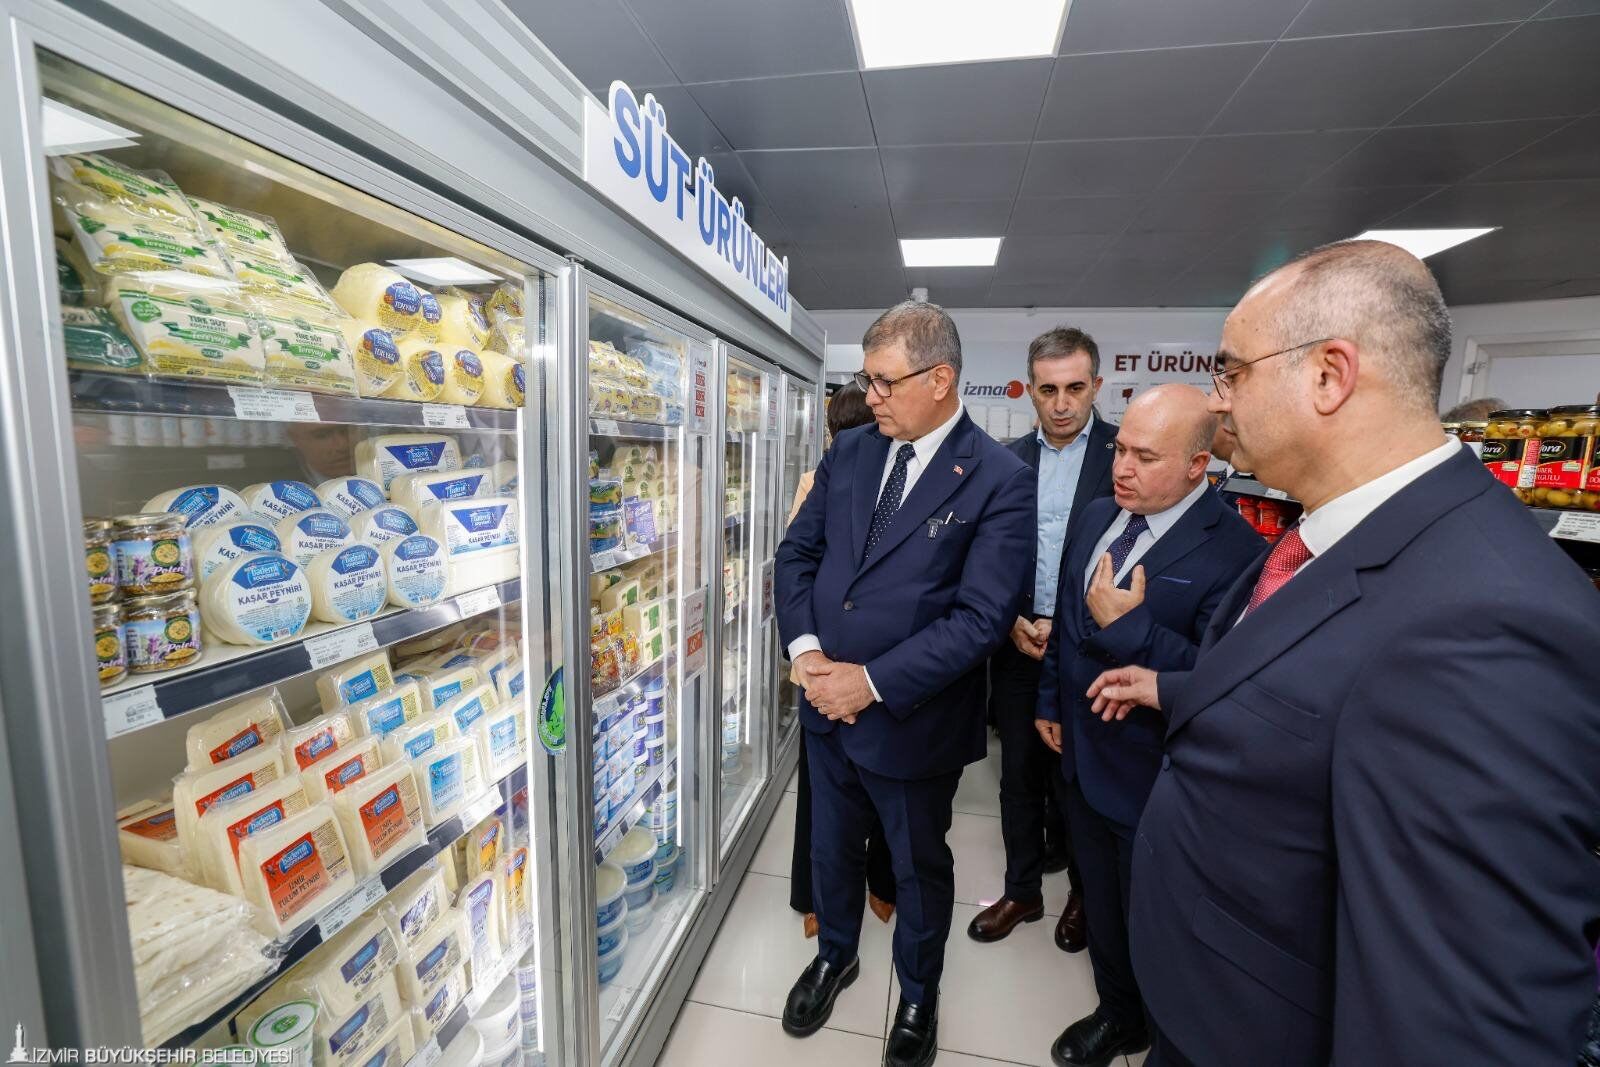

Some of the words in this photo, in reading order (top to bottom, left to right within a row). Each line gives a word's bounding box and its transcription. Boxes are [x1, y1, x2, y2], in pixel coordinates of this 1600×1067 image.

[614, 87, 690, 221] SÜT
[698, 161, 788, 313] ÜRÜNLERİ
[1115, 354, 1141, 372] ET
[1148, 350, 1227, 373] ÜRÜNL
[218, 547, 240, 560] KAŞ
[357, 570, 382, 584] PEYNİRİ
[238, 592, 269, 607] KAŞAR
[270, 583, 302, 598] PEYNİRİ
